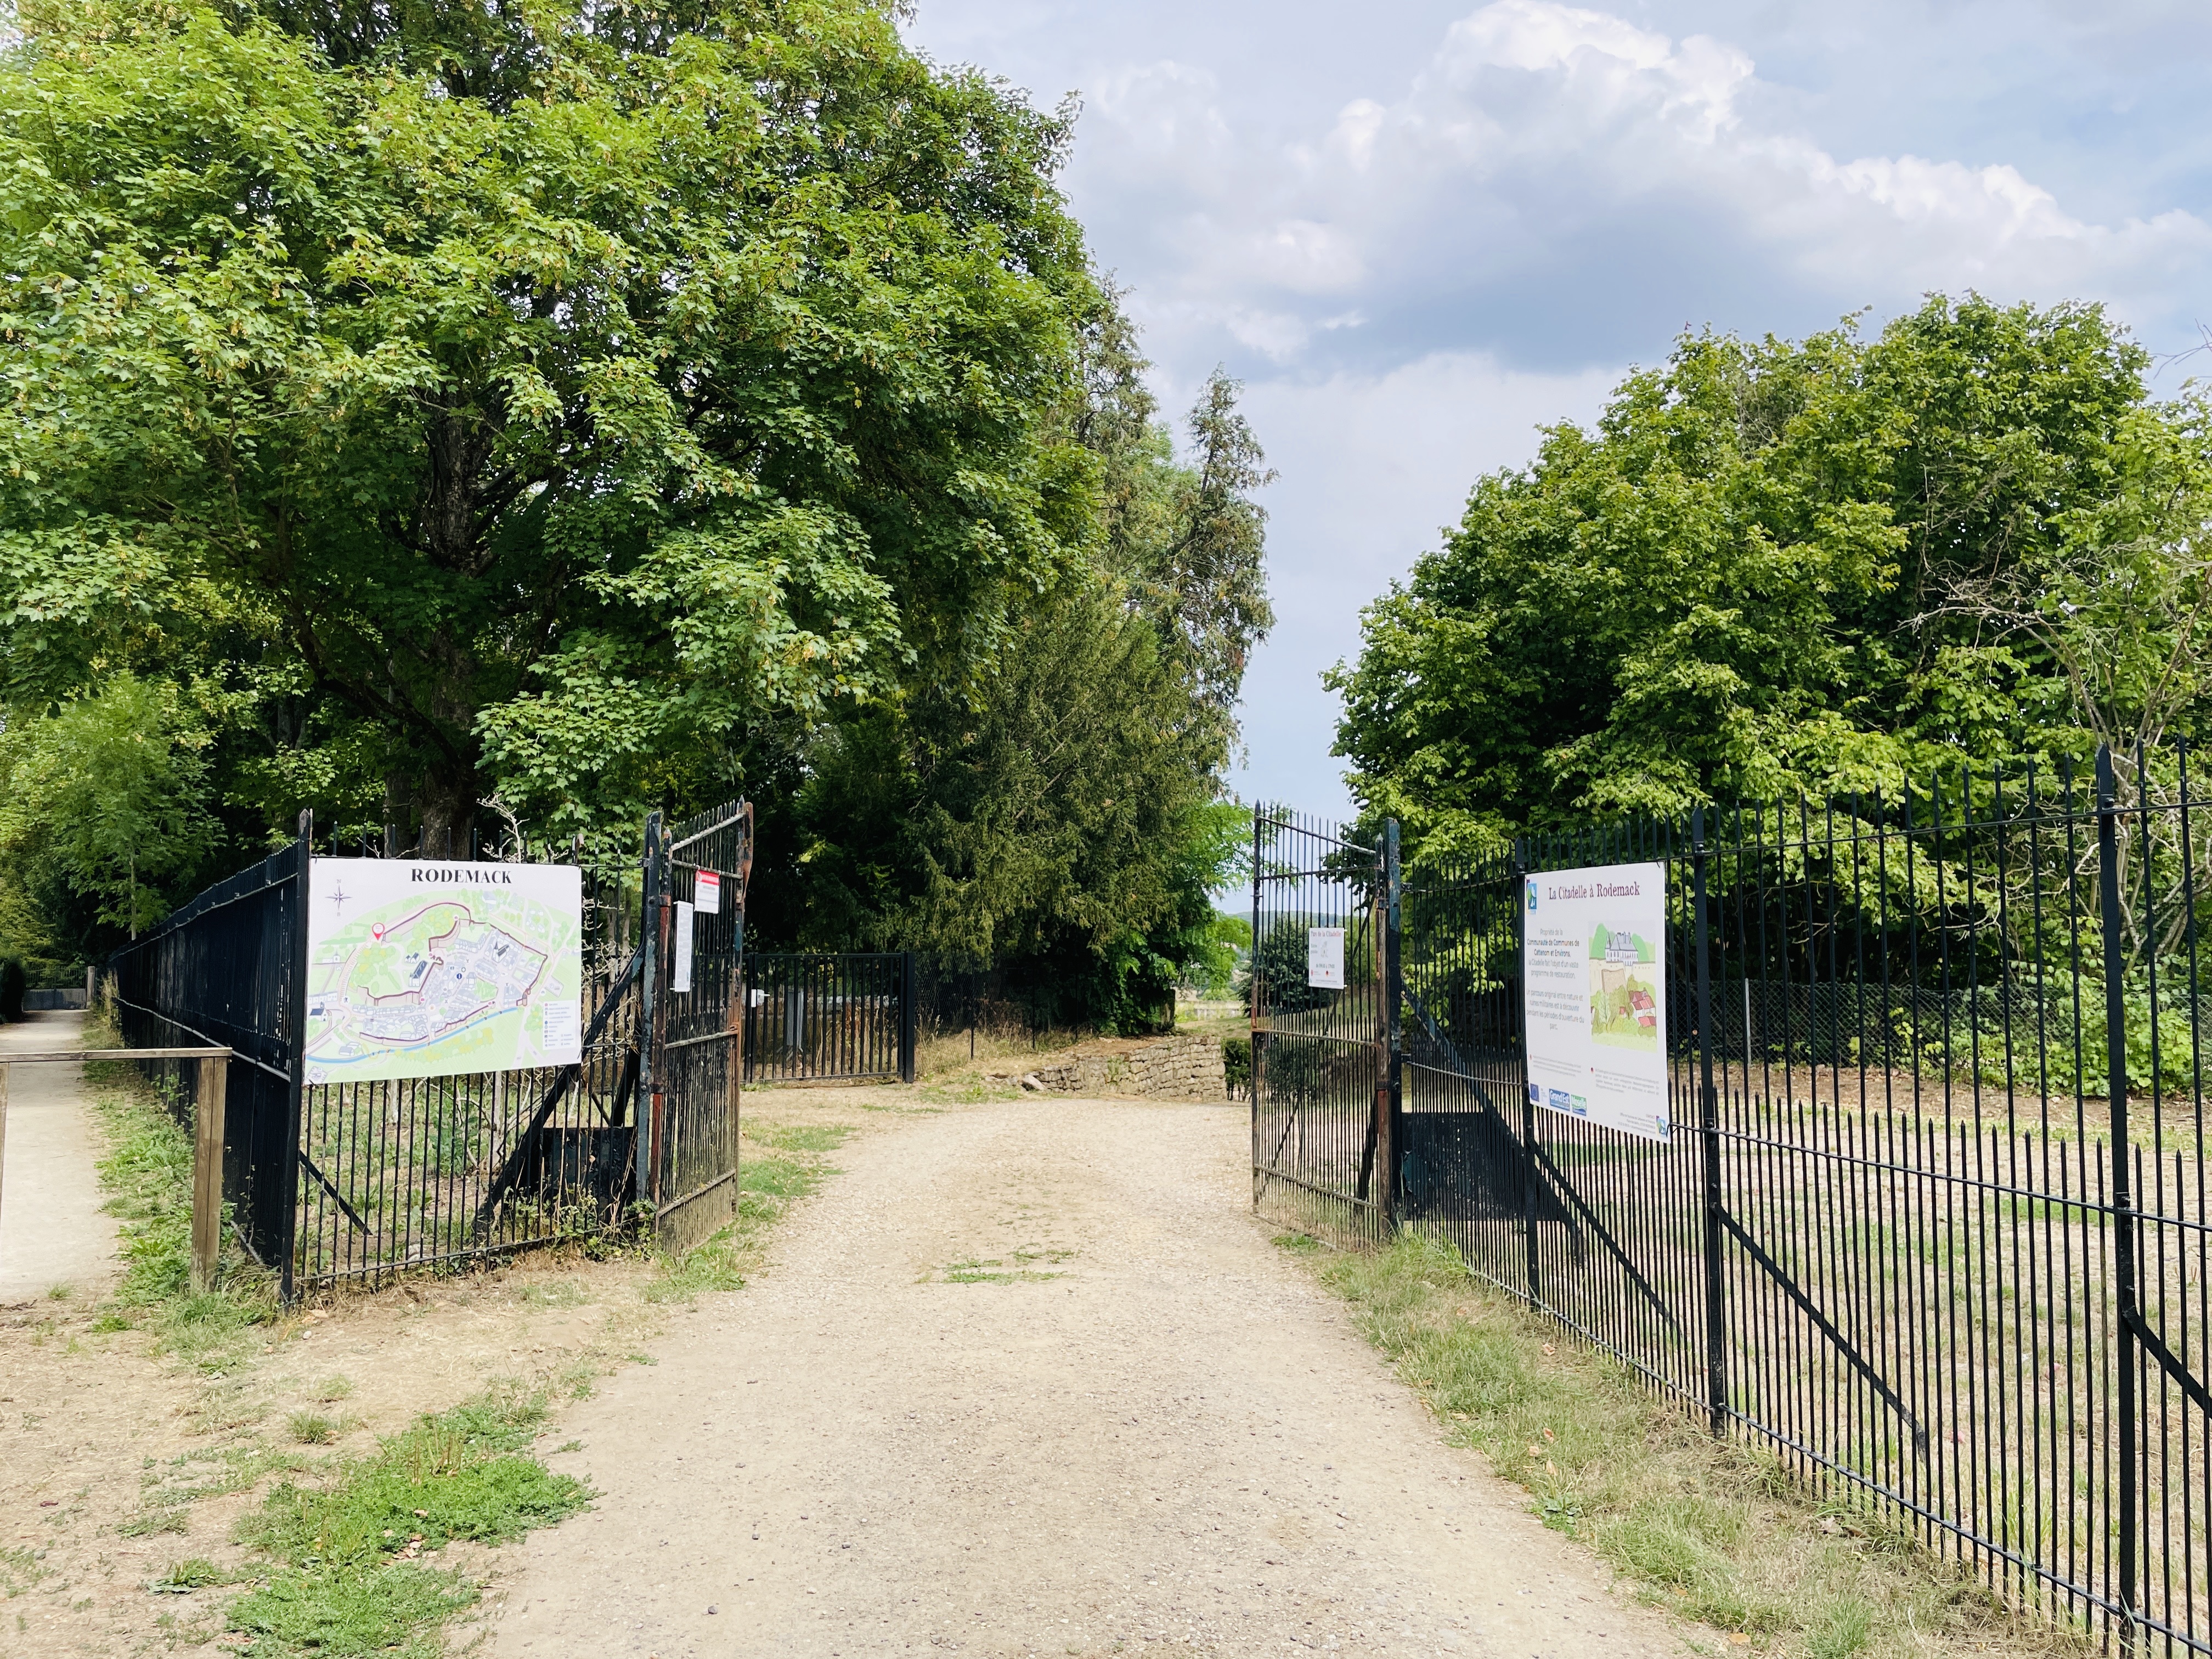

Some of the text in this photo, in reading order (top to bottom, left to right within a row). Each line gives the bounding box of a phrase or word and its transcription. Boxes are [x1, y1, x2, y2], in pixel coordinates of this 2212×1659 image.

[410, 868, 512, 884] RODEMACK
[1549, 881, 1640, 900] La Citadelle à Rodemack
[1544, 990, 1557, 1000] original
[1539, 1000, 1554, 1008] militaires
[1562, 1002, 1579, 1012] découvrir
[1558, 1012, 1579, 1022] d'ouverture
[1550, 1090, 1562, 1103] Grand
